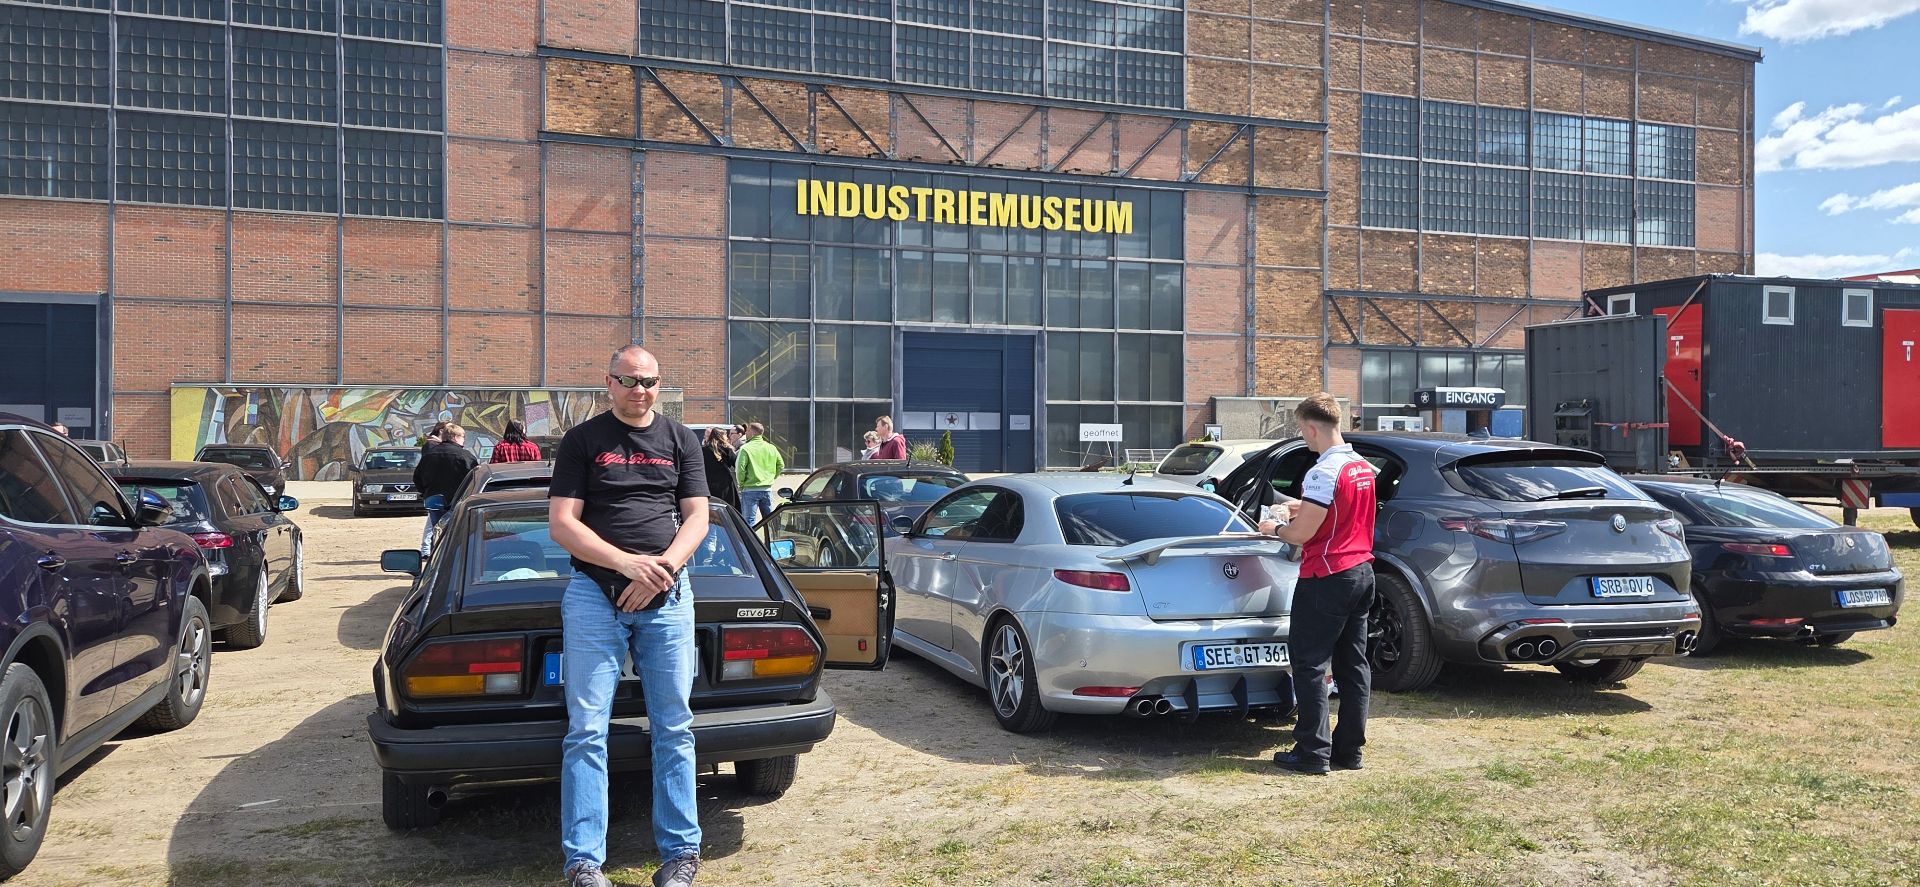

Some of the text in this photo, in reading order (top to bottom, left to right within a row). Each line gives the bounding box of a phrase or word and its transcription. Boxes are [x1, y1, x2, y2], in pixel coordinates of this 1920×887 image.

[797, 179, 1133, 235] INDUSTRIEMUSEUM
[1445, 391, 1496, 405] EINGANG
[1600, 578, 1653, 594] SRB QV 6
[1844, 592, 1861, 604] LOS
[1205, 647, 1234, 666] SEE
[1243, 646, 1260, 664] GT
[1263, 645, 1289, 663] 361
